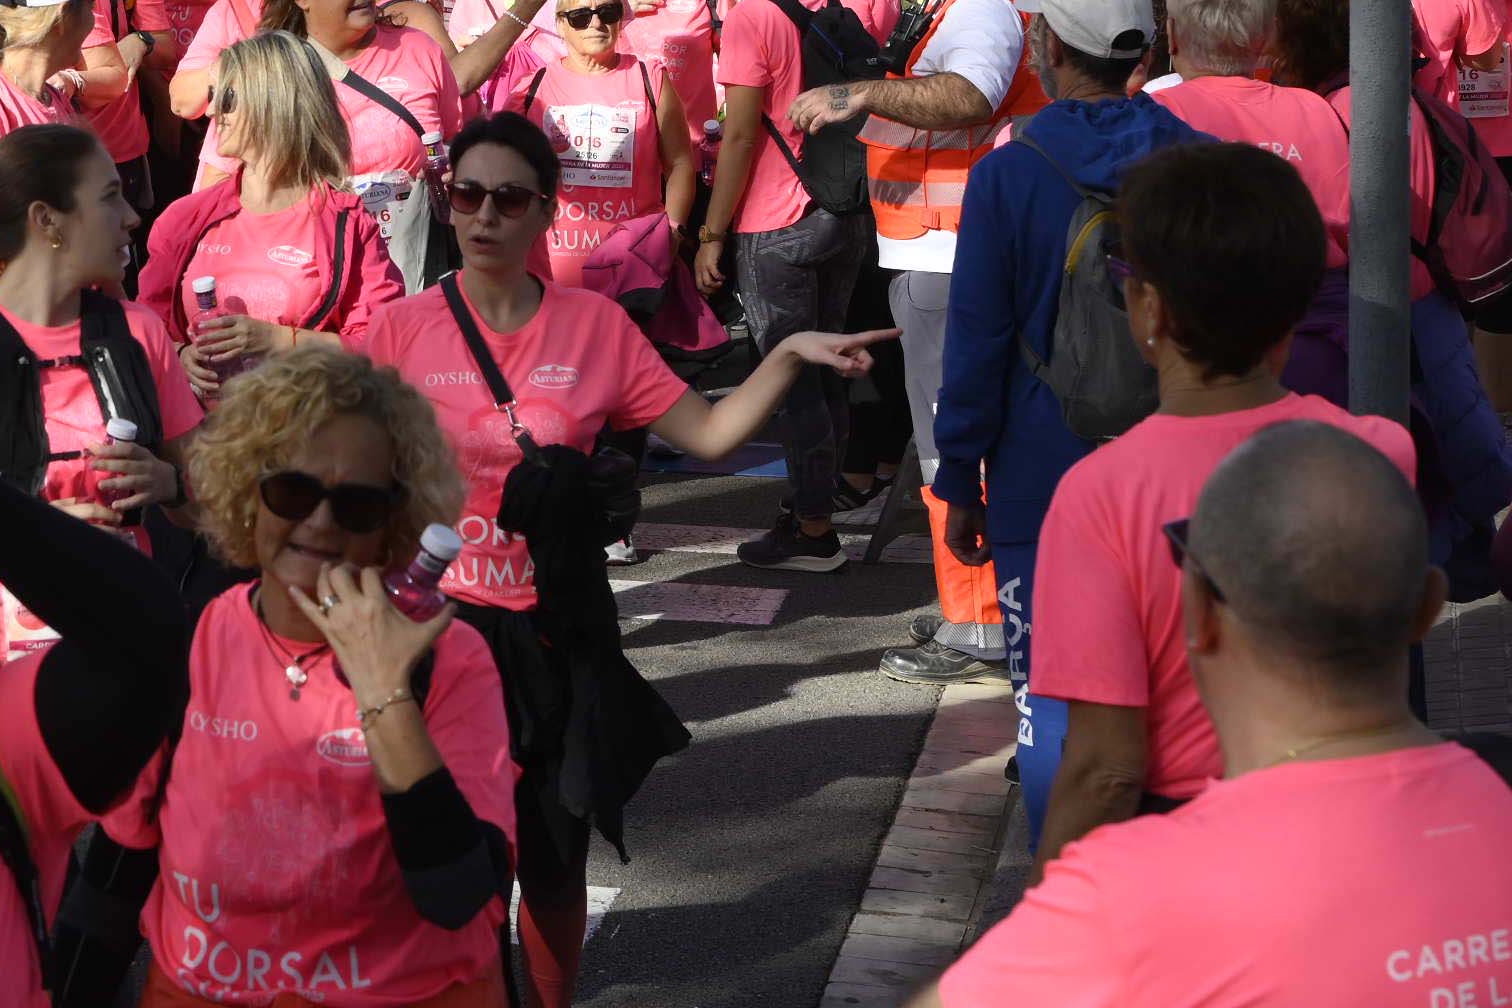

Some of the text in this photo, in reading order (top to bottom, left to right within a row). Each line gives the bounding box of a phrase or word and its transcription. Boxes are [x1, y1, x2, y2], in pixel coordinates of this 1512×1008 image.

[551, 228, 601, 250] SUM
[533, 374, 577, 386] ASTURIANA
[190, 711, 258, 742] OYSHO
[171, 871, 221, 923] TU
[183, 926, 370, 991] DORSAL
